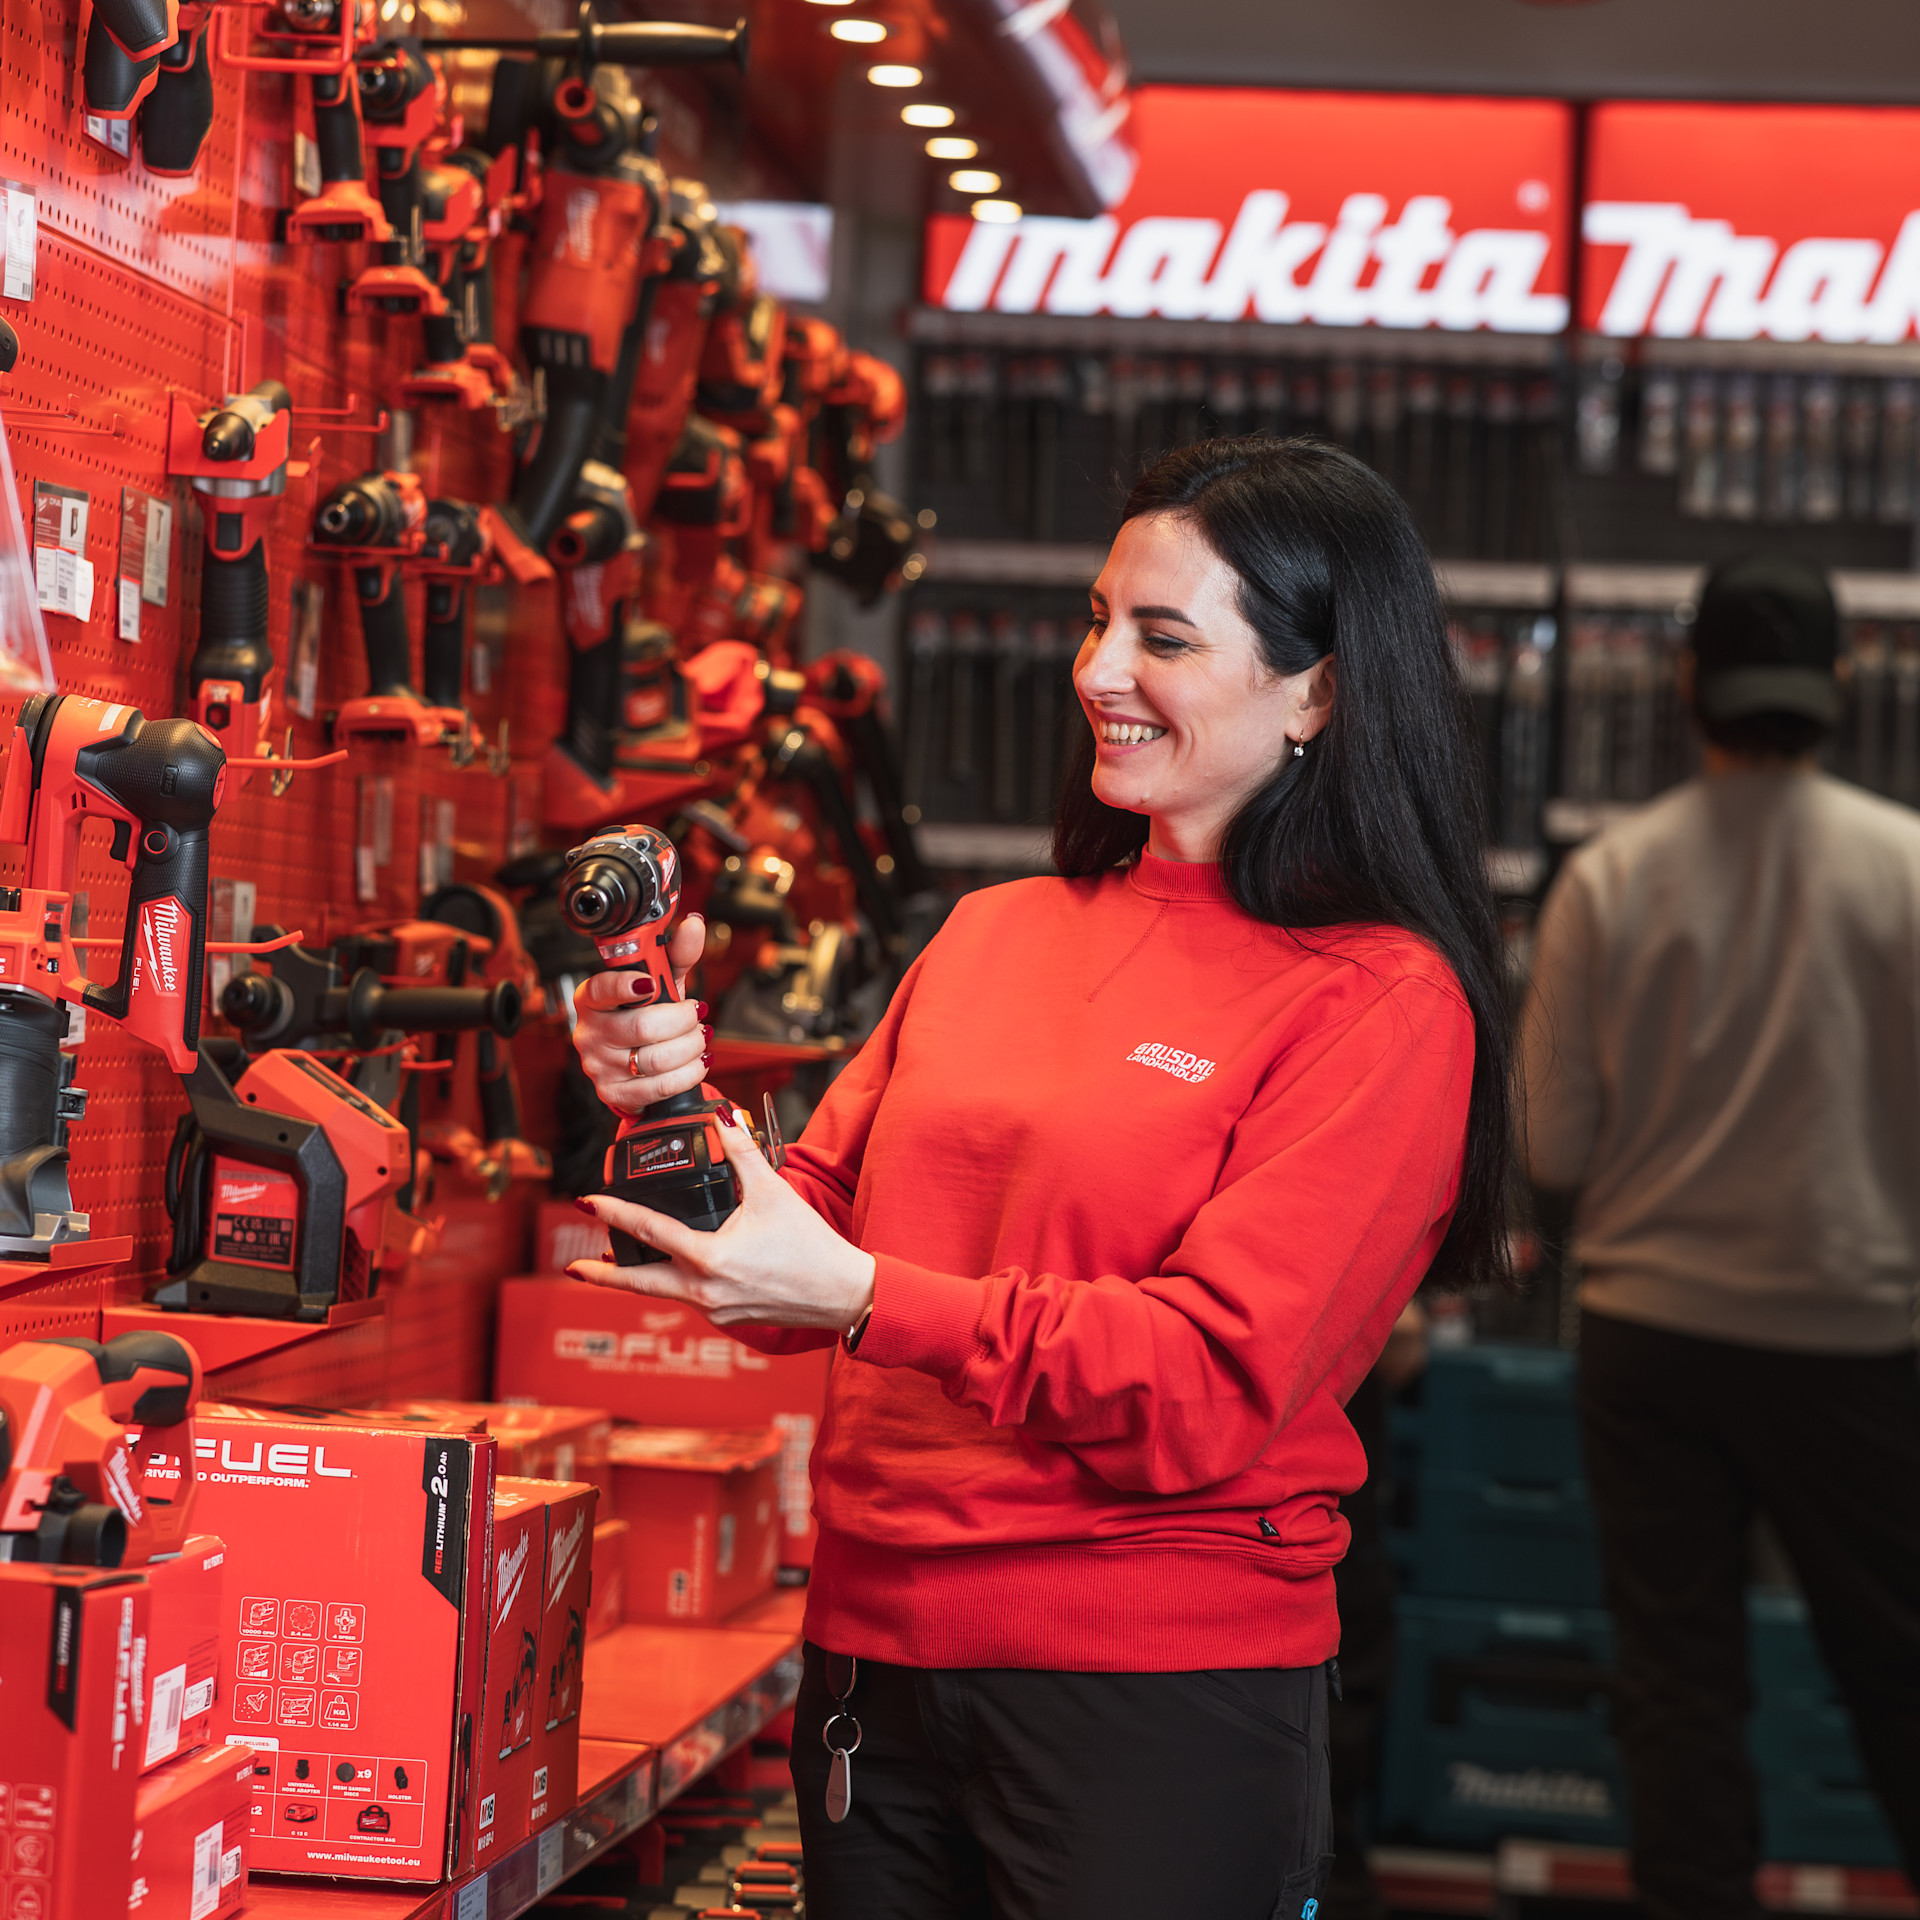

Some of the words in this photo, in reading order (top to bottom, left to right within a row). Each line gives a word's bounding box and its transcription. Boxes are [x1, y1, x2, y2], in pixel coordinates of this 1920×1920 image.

[153, 900, 180, 992] Milwaukee
[132, 957, 142, 996] FUEL
[632, 1138, 662, 1152] Milwaukee
[221, 1183, 267, 1199] Milwaukee
[621, 1331, 769, 1371] FUEL
[195, 1437, 352, 1478] FUEL
[145, 1467, 181, 1480] RIVEN
[549, 1507, 586, 1591] Milwaukee
[496, 1527, 530, 1611] Milwaukee
[333, 1708, 346, 1716] KG
[357, 1768, 372, 1779] x9
[349, 1834, 384, 1843] CONTRACTOR
[307, 1851, 421, 1867] www.milwaukeetool.eu
